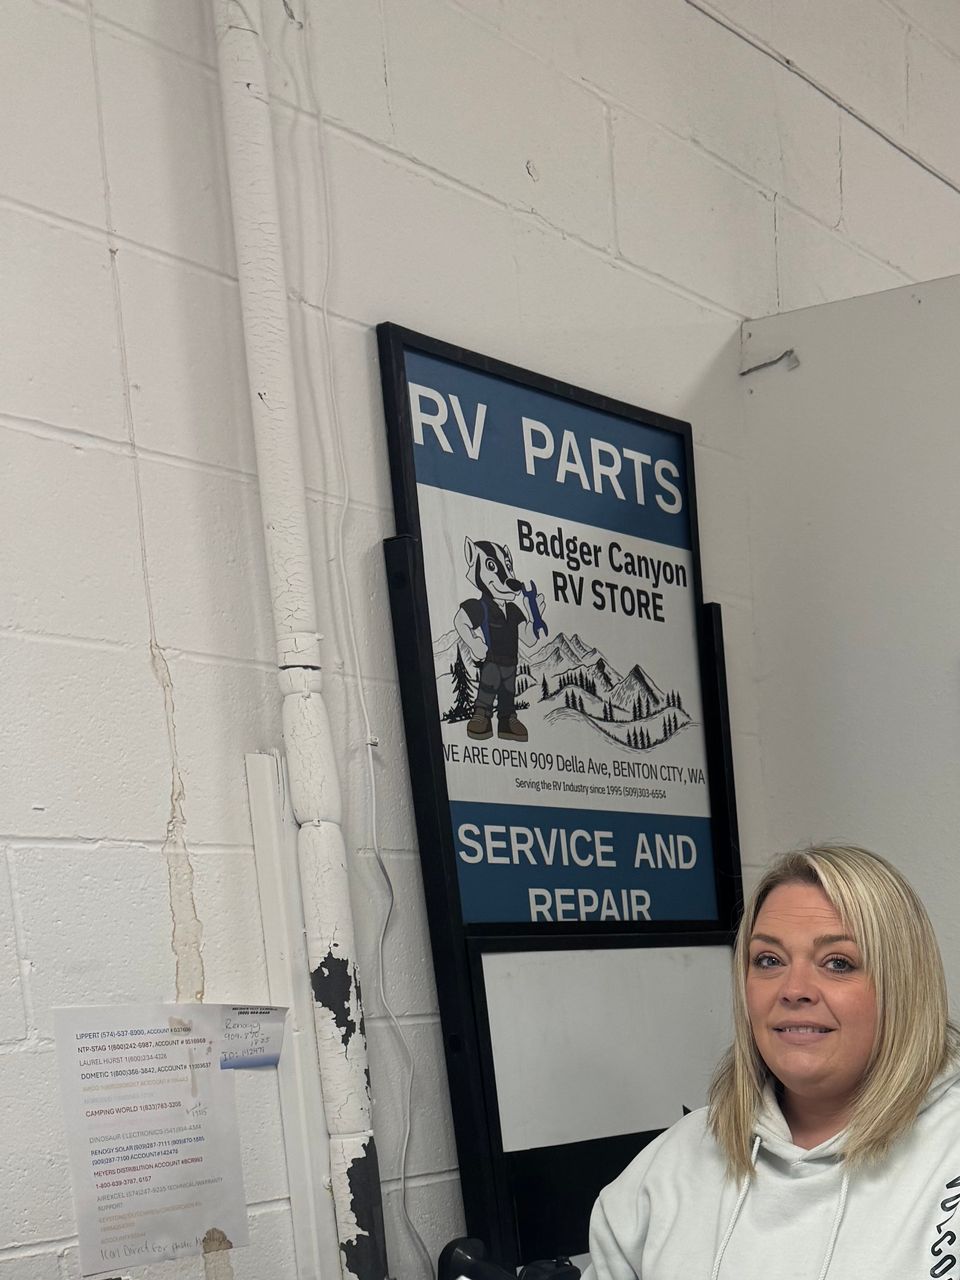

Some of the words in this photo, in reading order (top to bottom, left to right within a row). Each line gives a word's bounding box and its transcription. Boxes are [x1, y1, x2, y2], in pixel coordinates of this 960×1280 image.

[408, 381, 487, 460] RV
[522, 416, 683, 515] PARTS
[517, 519, 602, 571] Badger
[609, 542, 687, 588] Canyon
[552, 571, 585, 606] RV
[591, 580, 665, 622] STORE
[463, 746, 489, 765] ARE
[492, 748, 528, 768] OPEN
[530, 752, 553, 770] 909
[556, 755, 585, 773] Della
[588, 758, 611, 779] Ave,
[613, 760, 658, 780] BENTON
[660, 765, 687, 784] CITY,
[688, 768, 705, 784] WA
[515, 777, 540, 791] Serving
[541, 780, 551, 790] the
[553, 781, 561, 791] RV
[563, 781, 589, 795] Industry
[590, 785, 605, 794] since
[457, 823, 617, 869] SERVICE
[634, 832, 697, 870] AND
[528, 887, 652, 922] REPAIR
[85, 1108, 115, 1117] CAMPING
[116, 1106, 138, 1114] WORLD
